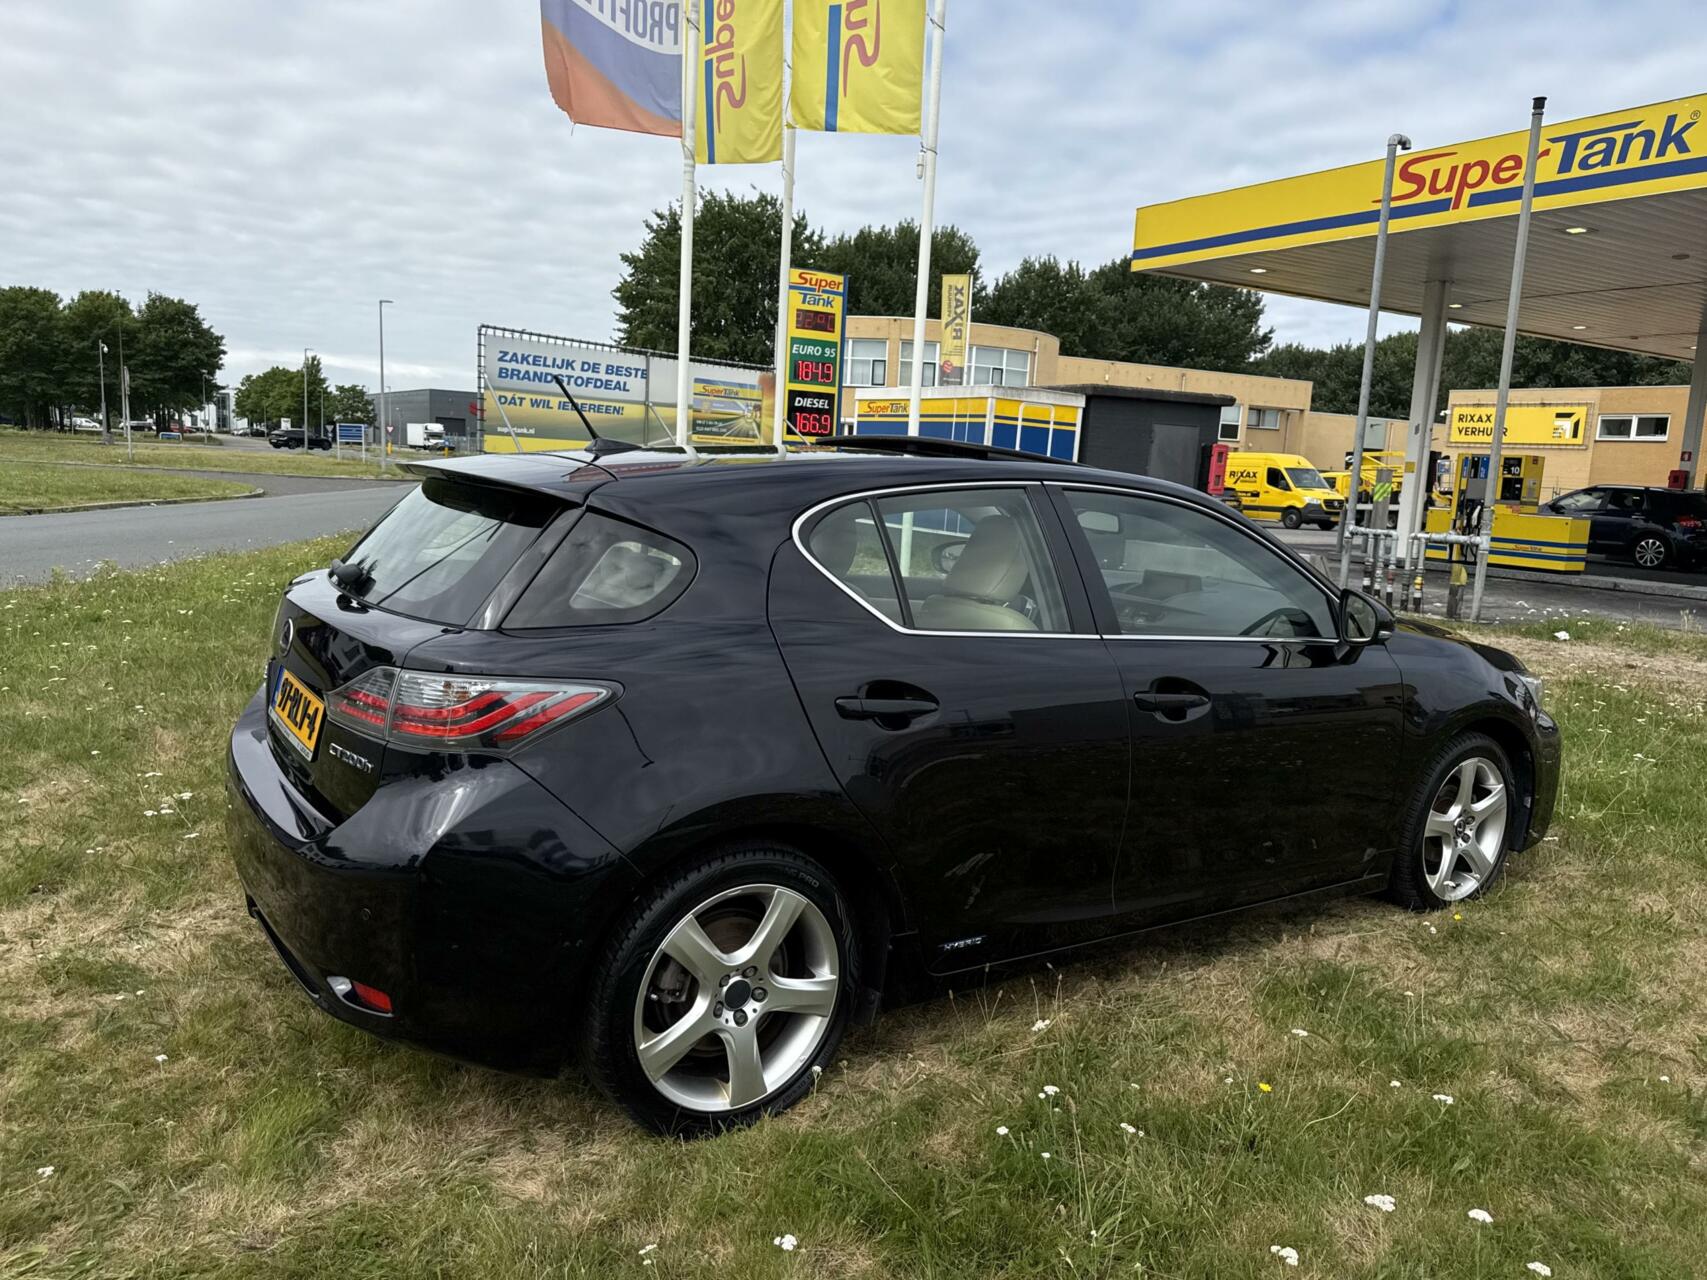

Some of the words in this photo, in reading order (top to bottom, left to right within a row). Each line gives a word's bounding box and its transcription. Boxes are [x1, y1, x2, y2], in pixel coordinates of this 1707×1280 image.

[790, 271, 842, 293] Super
[798, 292, 834, 308] Tank
[792, 344, 822, 356] EURO
[824, 347, 836, 358] 95
[497, 350, 576, 371] ZAKELIJK
[580, 360, 601, 374] DE
[605, 364, 648, 380] BESTE
[530, 398, 553, 410] WIL
[794, 397, 830, 409] DIESEL
[796, 412, 831, 434] 166.9
[1458, 413, 1493, 424] RIXAX
[1457, 426, 1508, 437] VERHUR
[1510, 466, 1520, 475] 10
